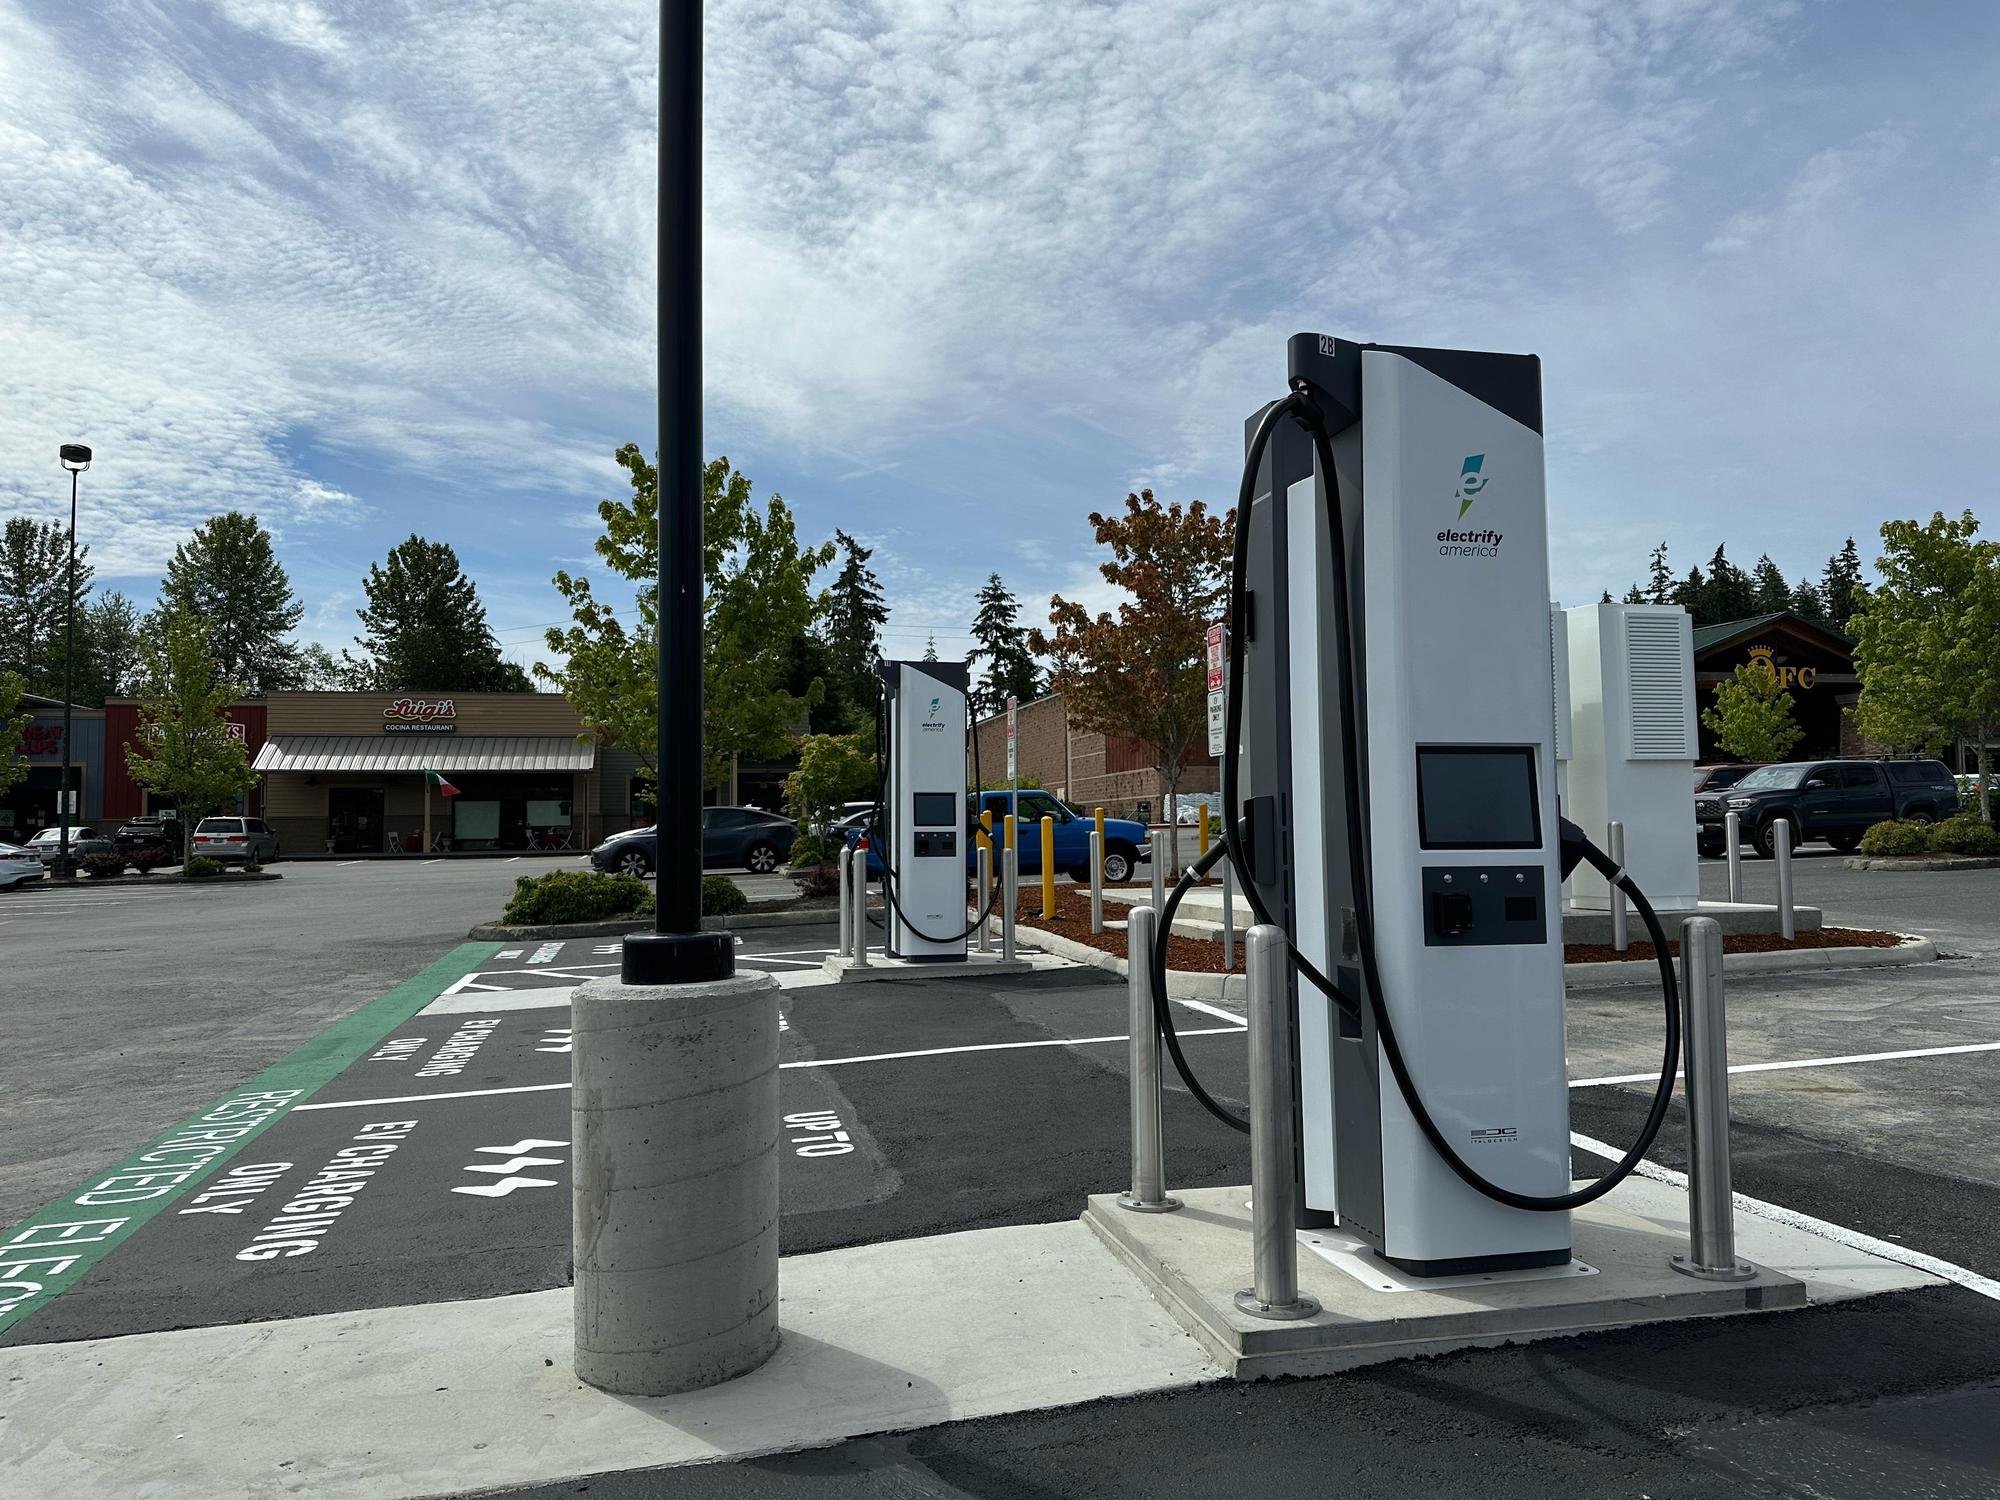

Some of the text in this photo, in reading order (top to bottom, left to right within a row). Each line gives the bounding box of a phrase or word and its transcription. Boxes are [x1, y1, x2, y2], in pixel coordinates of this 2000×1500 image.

[1320, 335, 1335, 355] 2B
[1437, 528, 1503, 546] electrify
[1440, 545, 1498, 557] america
[383, 699, 457, 721] Luigi's
[368, 1037, 428, 1061] ONLY
[414, 1029, 493, 1077] CHARGING
[75, 1089, 304, 1205] RESTRICTED
[783, 1110, 855, 1157] UP TO
[178, 1162, 294, 1214] ONLY
[235, 1120, 419, 1261] EV CHARGING
